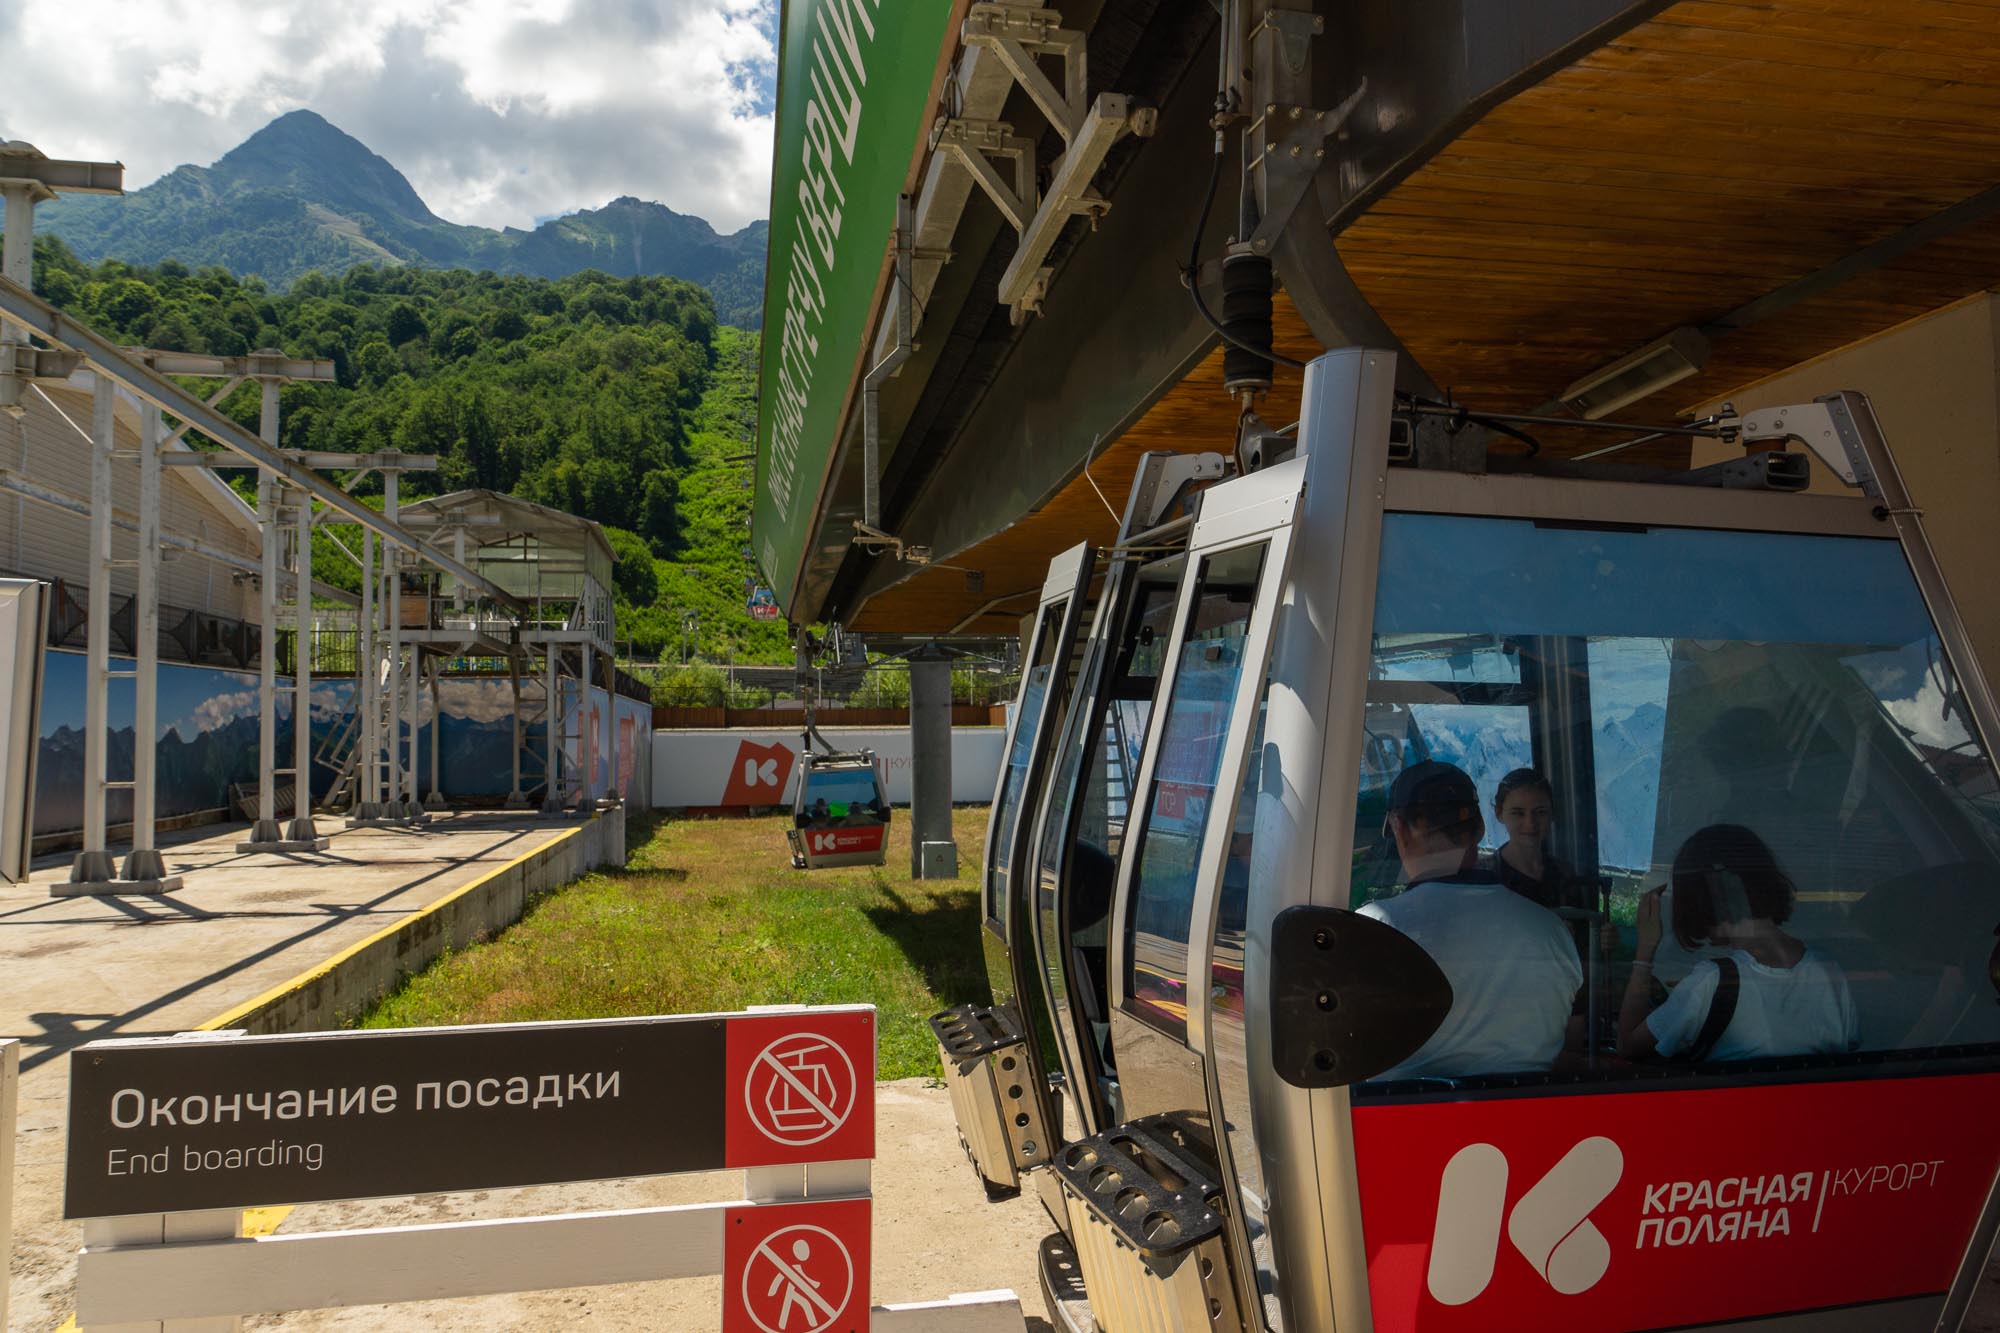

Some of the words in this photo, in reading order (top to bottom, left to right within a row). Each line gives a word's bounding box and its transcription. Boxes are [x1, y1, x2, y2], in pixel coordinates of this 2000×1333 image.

[799, 0, 882, 272] ВЕРШИ
[774, 216, 825, 459] НАВСТРЕЧУ
[111, 1085, 397, 1128] Окончание
[416, 1071, 620, 1110] посадки
[108, 1146, 168, 1176] End
[184, 1139, 323, 1171] boarding
[1832, 1160, 1944, 1196] КУРОРТ
[1642, 1171, 1813, 1215] КРАСНАЯ
[1636, 1207, 1790, 1249] ПОЛЯНА
